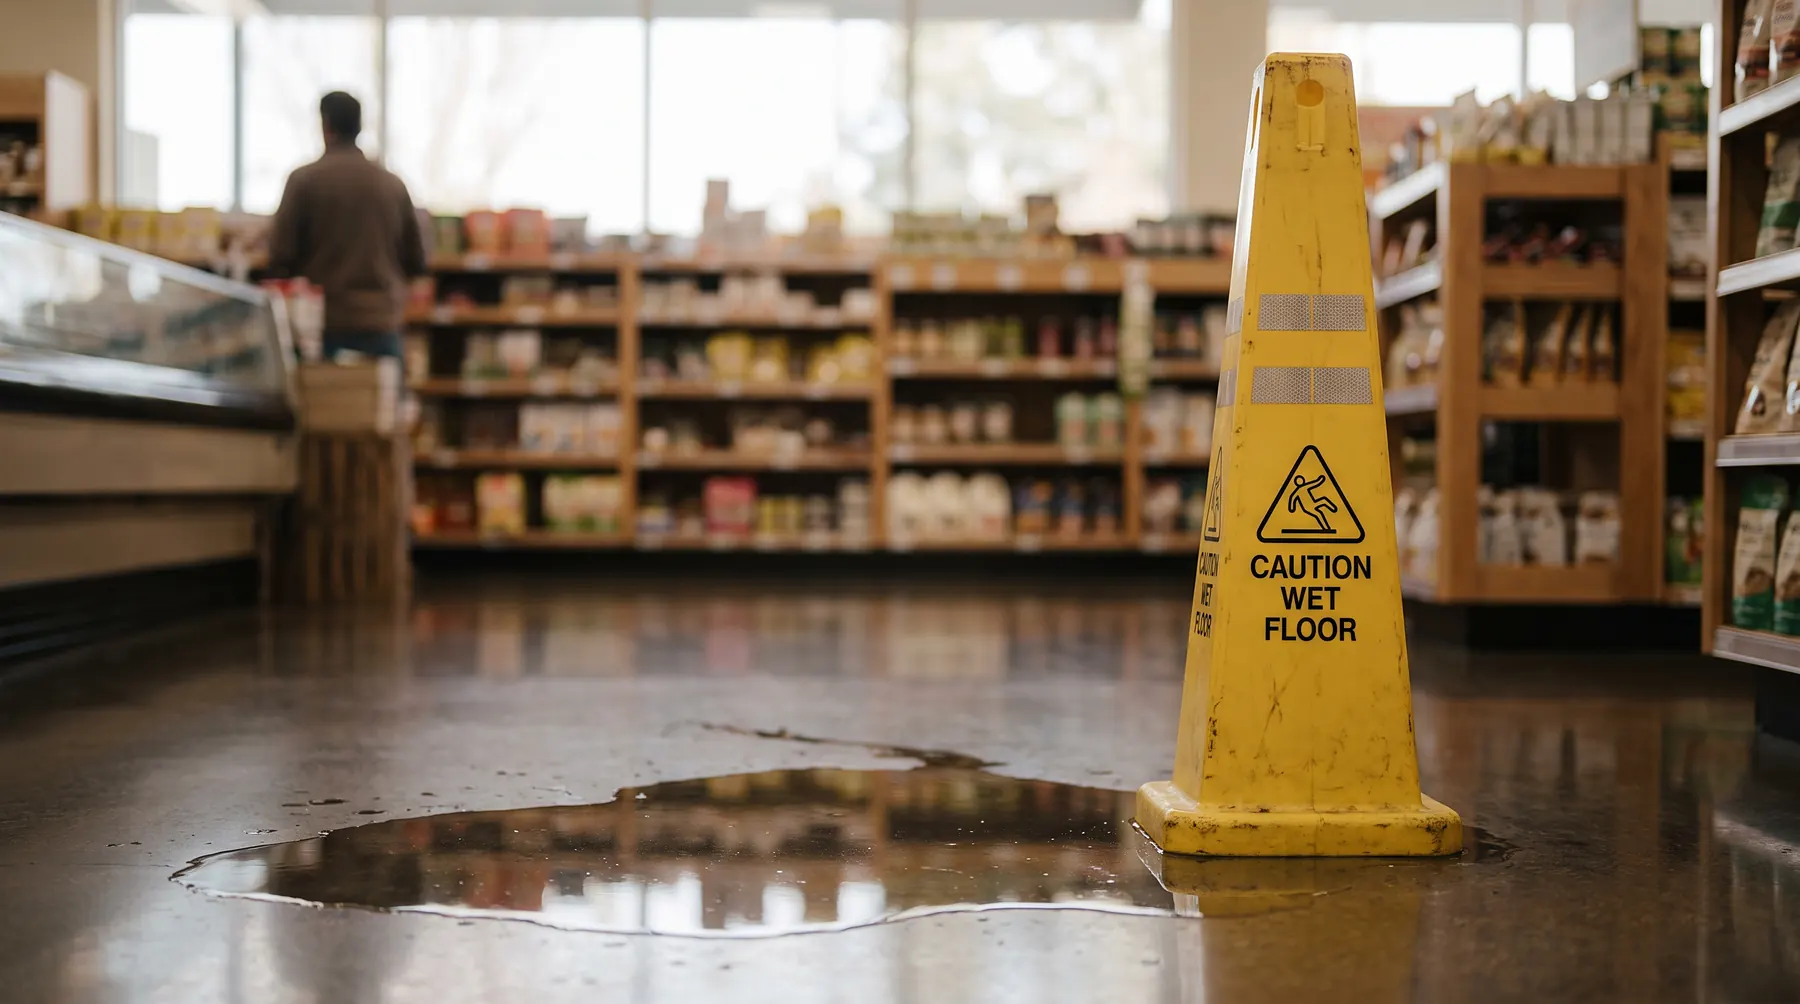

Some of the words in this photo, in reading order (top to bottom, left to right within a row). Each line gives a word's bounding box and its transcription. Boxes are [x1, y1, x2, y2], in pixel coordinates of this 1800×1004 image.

[1250, 554, 1372, 580] CAUTION
[1201, 583, 1213, 607] WET
[1280, 586, 1341, 611] WET
[1193, 611, 1212, 638] FLOOR
[1265, 616, 1357, 642] FLOOR
